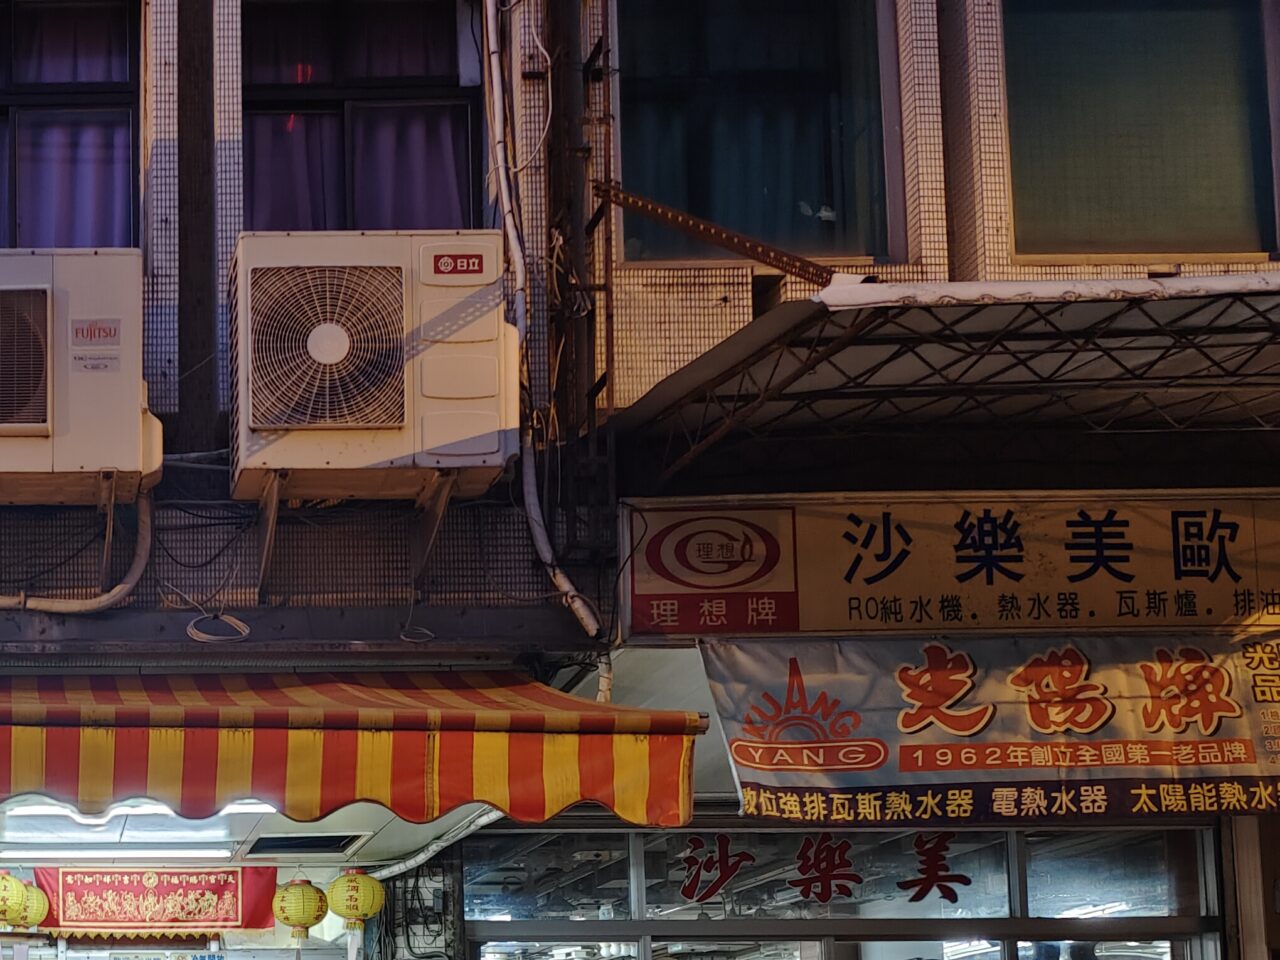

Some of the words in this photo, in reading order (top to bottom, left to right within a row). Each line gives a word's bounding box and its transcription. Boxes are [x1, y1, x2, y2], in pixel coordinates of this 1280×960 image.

[457, 257, 479, 271] 日立
[75, 326, 117, 340] FUJITSU
[695, 542, 735, 559] 理想
[841, 508, 1243, 586] 沙樂美歐
[650, 596, 777, 627] 理想牌
[742, 656, 863, 739] KUANG
[896, 643, 1242, 736] 光陽牌
[748, 746, 867, 765] YANG
[912, 741, 1248, 767] 1962年創立全國第一老品牌
[991, 785, 1108, 817] 電熱水器
[1130, 780, 1280, 813] 太陽能熱水
[680, 831, 972, 904] 沙樂美
